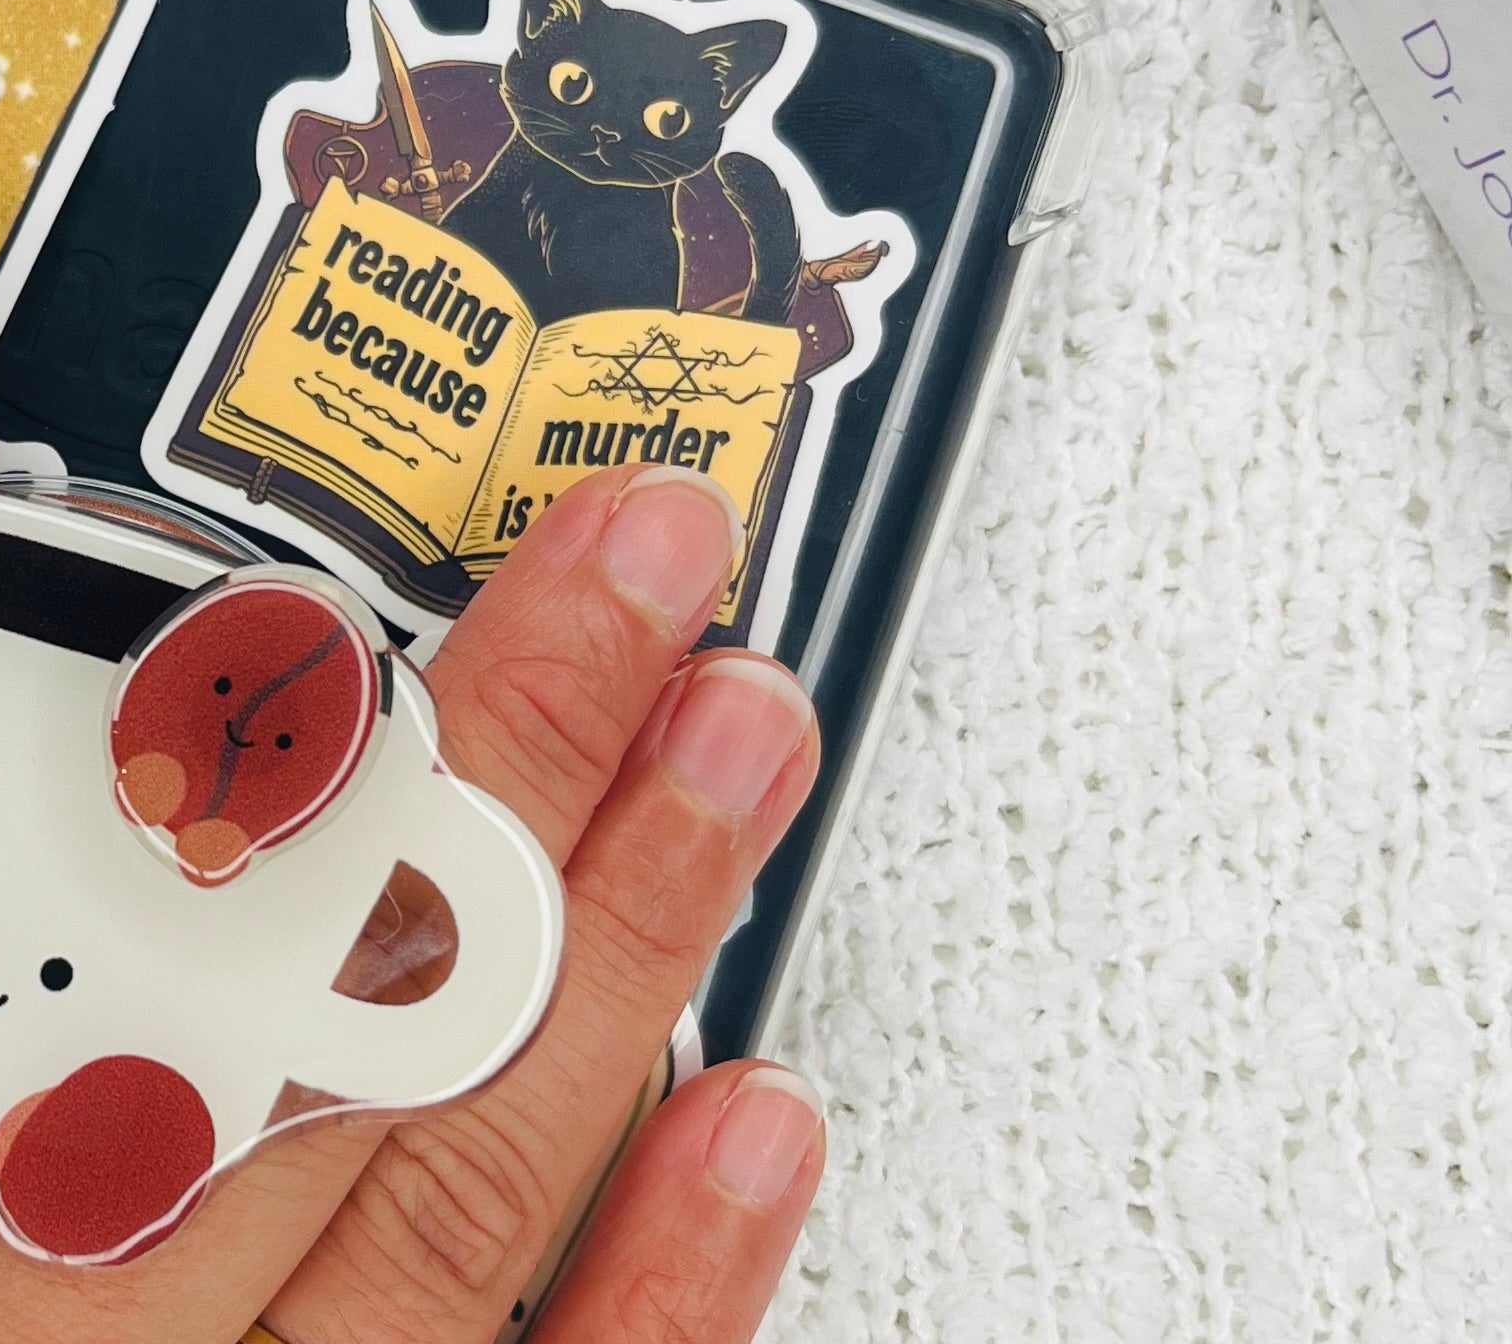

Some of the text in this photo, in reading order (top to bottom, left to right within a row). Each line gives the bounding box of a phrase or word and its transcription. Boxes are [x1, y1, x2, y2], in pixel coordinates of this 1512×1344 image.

[1402, 19, 1512, 248] Dr. Jo
[291, 278, 488, 429] because
[323, 223, 513, 367] reading
[494, 484, 534, 542] is
[535, 409, 731, 474] murder
